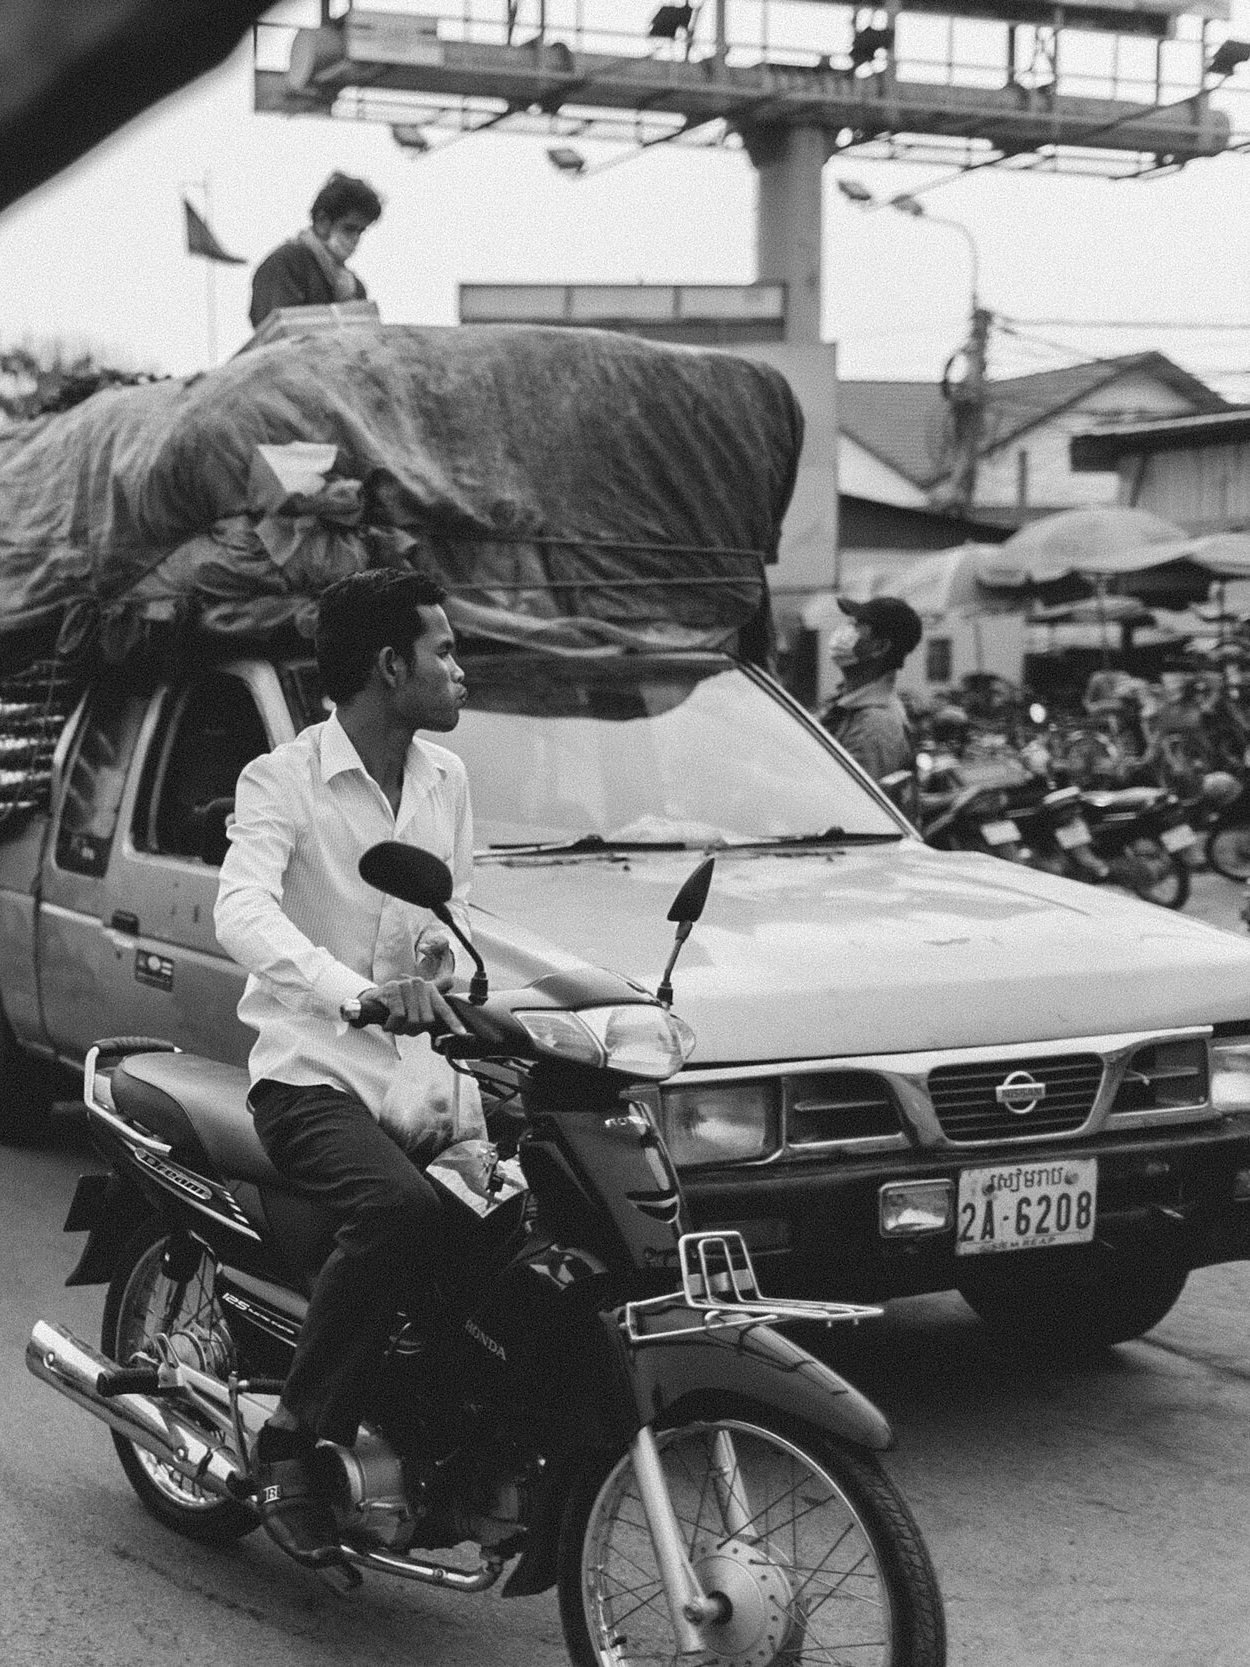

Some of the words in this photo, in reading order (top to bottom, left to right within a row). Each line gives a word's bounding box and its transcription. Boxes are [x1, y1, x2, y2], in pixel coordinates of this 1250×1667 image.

[139, 1153, 206, 1196] Dream
[958, 1190, 1091, 1241] 2A-6208
[222, 1292, 250, 1311] 125
[465, 1319, 507, 1361] HONDA
